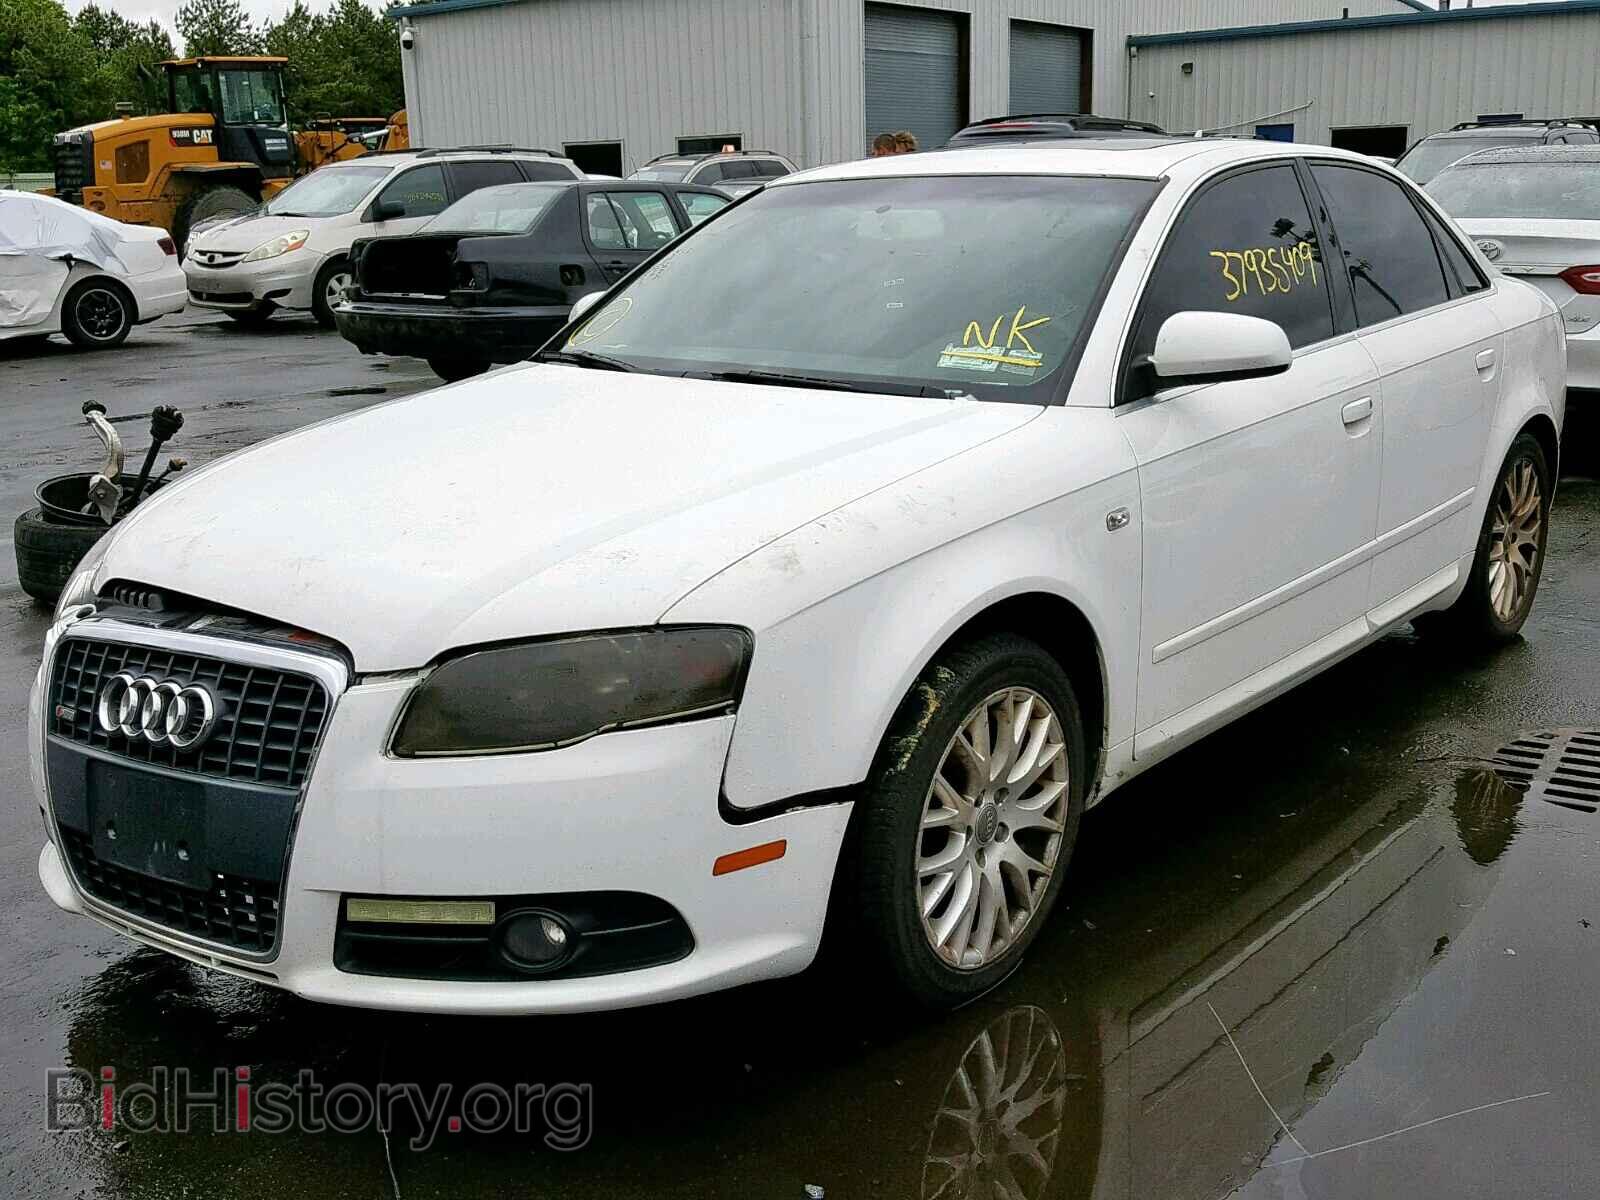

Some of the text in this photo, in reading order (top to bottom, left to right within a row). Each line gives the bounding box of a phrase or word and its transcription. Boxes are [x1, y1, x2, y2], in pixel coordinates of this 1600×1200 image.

[192, 129, 213, 144] CAT
[1209, 241, 1317, 301] 37935409
[963, 304, 1051, 355] NK
